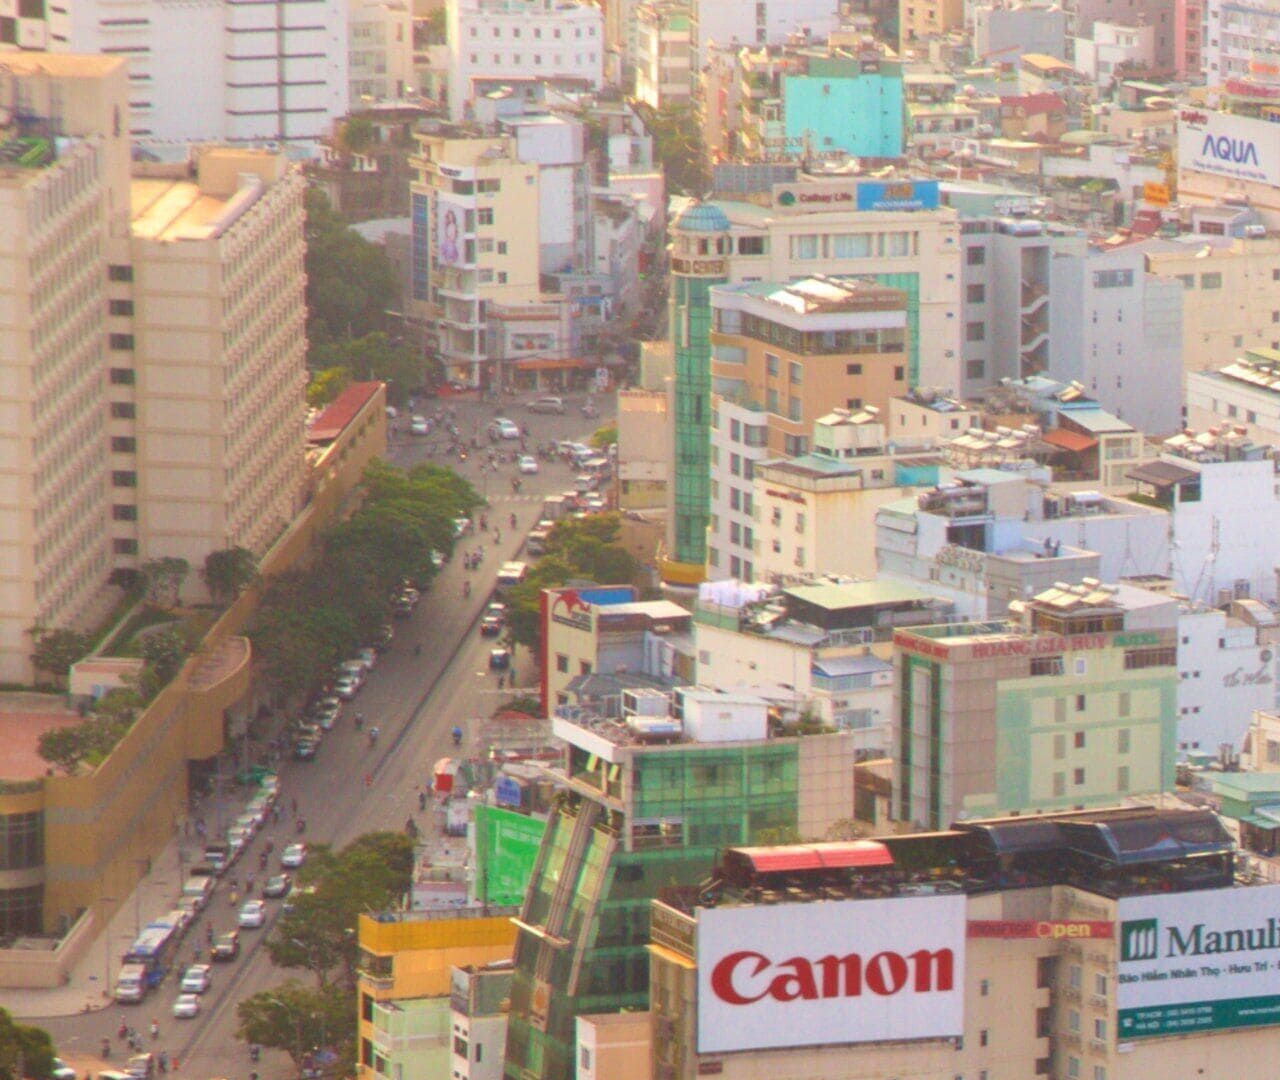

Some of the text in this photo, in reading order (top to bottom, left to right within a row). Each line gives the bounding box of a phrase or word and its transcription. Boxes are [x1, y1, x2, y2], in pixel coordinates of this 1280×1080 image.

[1202, 134, 1258, 166] AQUA
[1036, 921, 1092, 939] Open
[711, 948, 953, 1005] Canon
